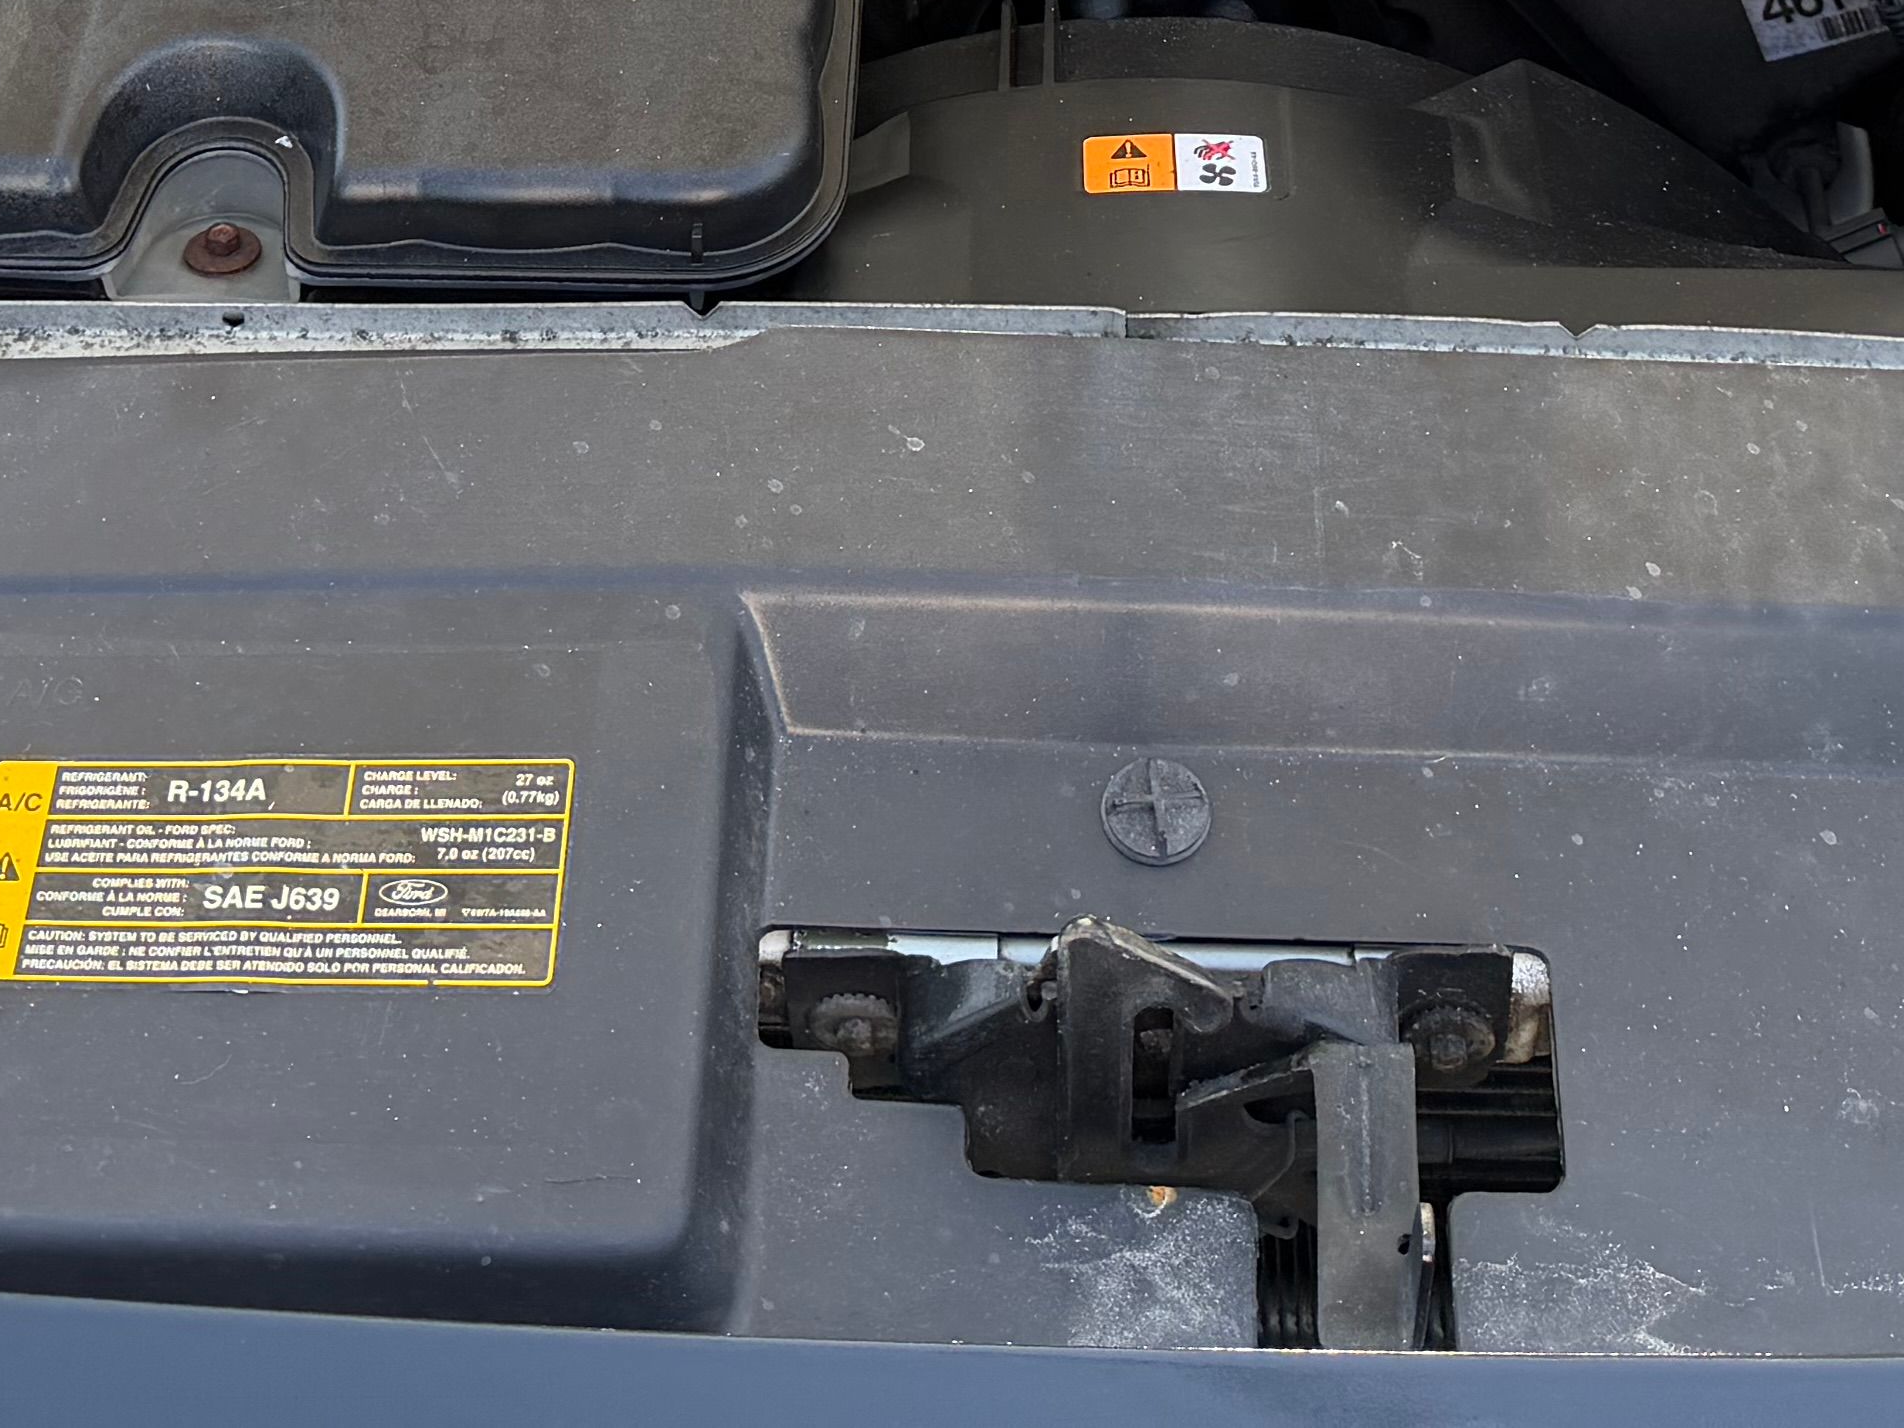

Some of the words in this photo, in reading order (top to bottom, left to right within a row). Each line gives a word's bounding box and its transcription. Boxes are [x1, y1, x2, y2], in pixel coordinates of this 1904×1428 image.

[364, 771, 414, 781] CHARGE
[416, 771, 457, 781] LEVEL:
[515, 774, 533, 786] 27
[537, 776, 554, 786] oz
[167, 778, 266, 803] R-134A
[362, 785, 411, 795] CHARGE
[501, 790, 560, 805] (0.77kg)
[56, 799, 150, 810] REFRIGERANTE:
[359, 799, 402, 809] CARGA
[404, 799, 421, 809] DE
[423, 799, 483, 809] LLENADO:
[50, 824, 133, 835] REFRIGERANT
[165, 824, 199, 835] FORD
[201, 824, 235, 835] SPEC:
[420, 827, 556, 843] WSH-M1C231-B
[48, 837, 116, 849] LUBRIFIANT
[126, 838, 193, 849] CONFORME
[207, 837, 223, 848] LA
[225, 837, 268, 848] NORME
[270, 837, 304, 849] FORD
[45, 851, 69, 863] USE
[71, 851, 113, 863] ACEITE
[116, 852, 148, 863] PARA
[151, 851, 249, 863] REFRIGERANTES
[251, 851, 319, 863] CONFORME
[332, 852, 376, 863] NORMA
[379, 852, 416, 863] FORD:
[461, 850, 479, 860] oz
[481, 847, 536, 862] (207cc)
[92, 877, 154, 889] COMPLIES
[156, 878, 190, 889] WITH:
[36, 891, 104, 902] CONFORME
[118, 891, 134, 902] LA
[136, 891, 181, 903] NORME
[203, 885, 265, 910] SAE
[270, 884, 340, 911] J639
[391, 882, 435, 901] Ford
[102, 906, 152, 917] CUMPLE
[154, 906, 185, 917] CON:
[28, 930, 86, 941] CAUTION:
[88, 931, 137, 942] SYSTEM
[140, 931, 155, 942] TO
[158, 931, 175, 942] BE
[178, 930, 237, 942] SERVICED
[239, 930, 256, 942] BY
[259, 931, 323, 944] QUALIFIED
[325, 933, 402, 944] PERSONNEL.
[24, 944, 54, 956] MISE
[57, 945, 74, 956] EN
[77, 945, 120, 956] GARDE
[129, 945, 146, 957] NE
[148, 945, 202, 957] CONFIER
[315, 948, 333, 959] UN
[335, 947, 409, 959] PERSONNEL
[21, 957, 105, 970] PRECAUCIÓN:
[107, 959, 124, 971] EL
[126, 959, 178, 971] SISTEMA
[180, 959, 213, 971] DEBE
[215, 959, 240, 971] SER
[242, 959, 305, 973] ATENDIDO
[307, 962, 340, 973] SOLO
[343, 962, 369, 973] POR
[372, 962, 438, 974] PERSONAL
